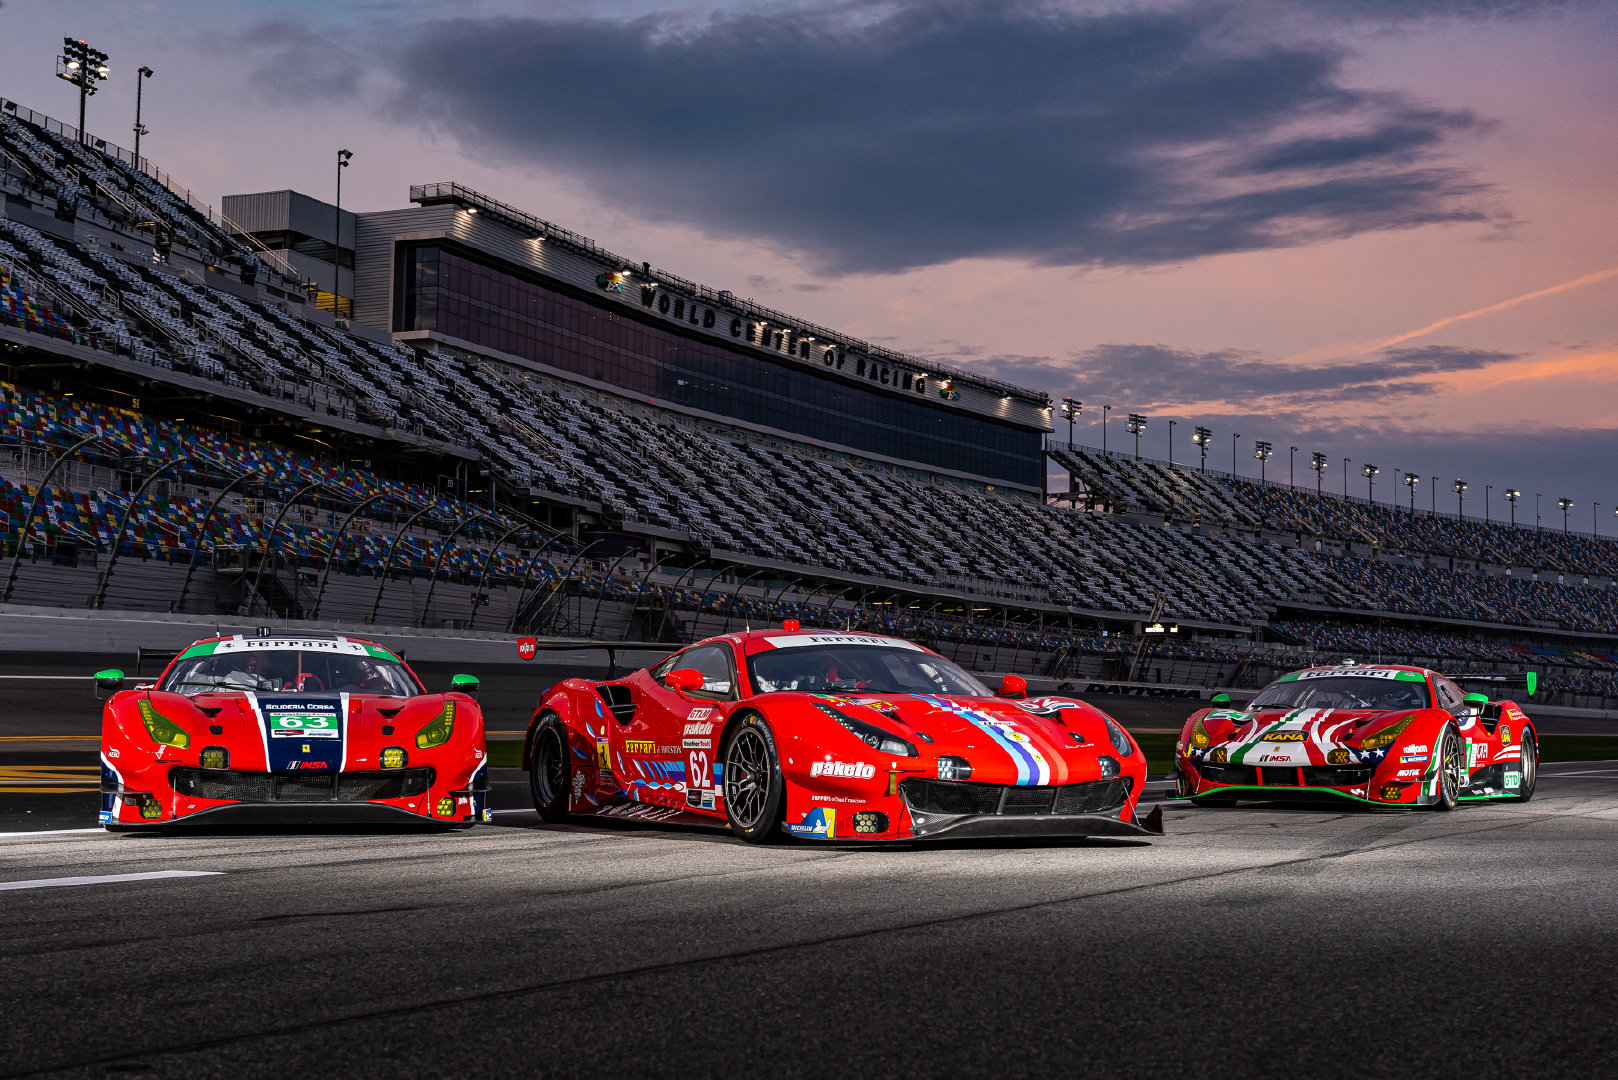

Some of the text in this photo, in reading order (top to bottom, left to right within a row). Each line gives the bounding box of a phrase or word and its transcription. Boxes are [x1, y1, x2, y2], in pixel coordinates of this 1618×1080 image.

[641, 285, 926, 394] WORLD CENTER OF RACING
[246, 641, 338, 649] Ferrari
[808, 636, 889, 645] Ferrari
[1303, 670, 1391, 678] Ferrari
[1085, 683, 1201, 698] DAYTONA
[690, 709, 712, 718] GTLM
[279, 716, 329, 728] 63
[683, 721, 714, 736] pakelo
[1263, 733, 1304, 741] RANA
[625, 740, 656, 754] Ferrari
[299, 761, 328, 770] IMSA
[689, 750, 711, 788] 62
[810, 760, 876, 780] pakelo
[1396, 768, 1421, 777] MOTUL
[1504, 774, 1518, 786] GTD
[790, 824, 813, 832] MICHELIN
